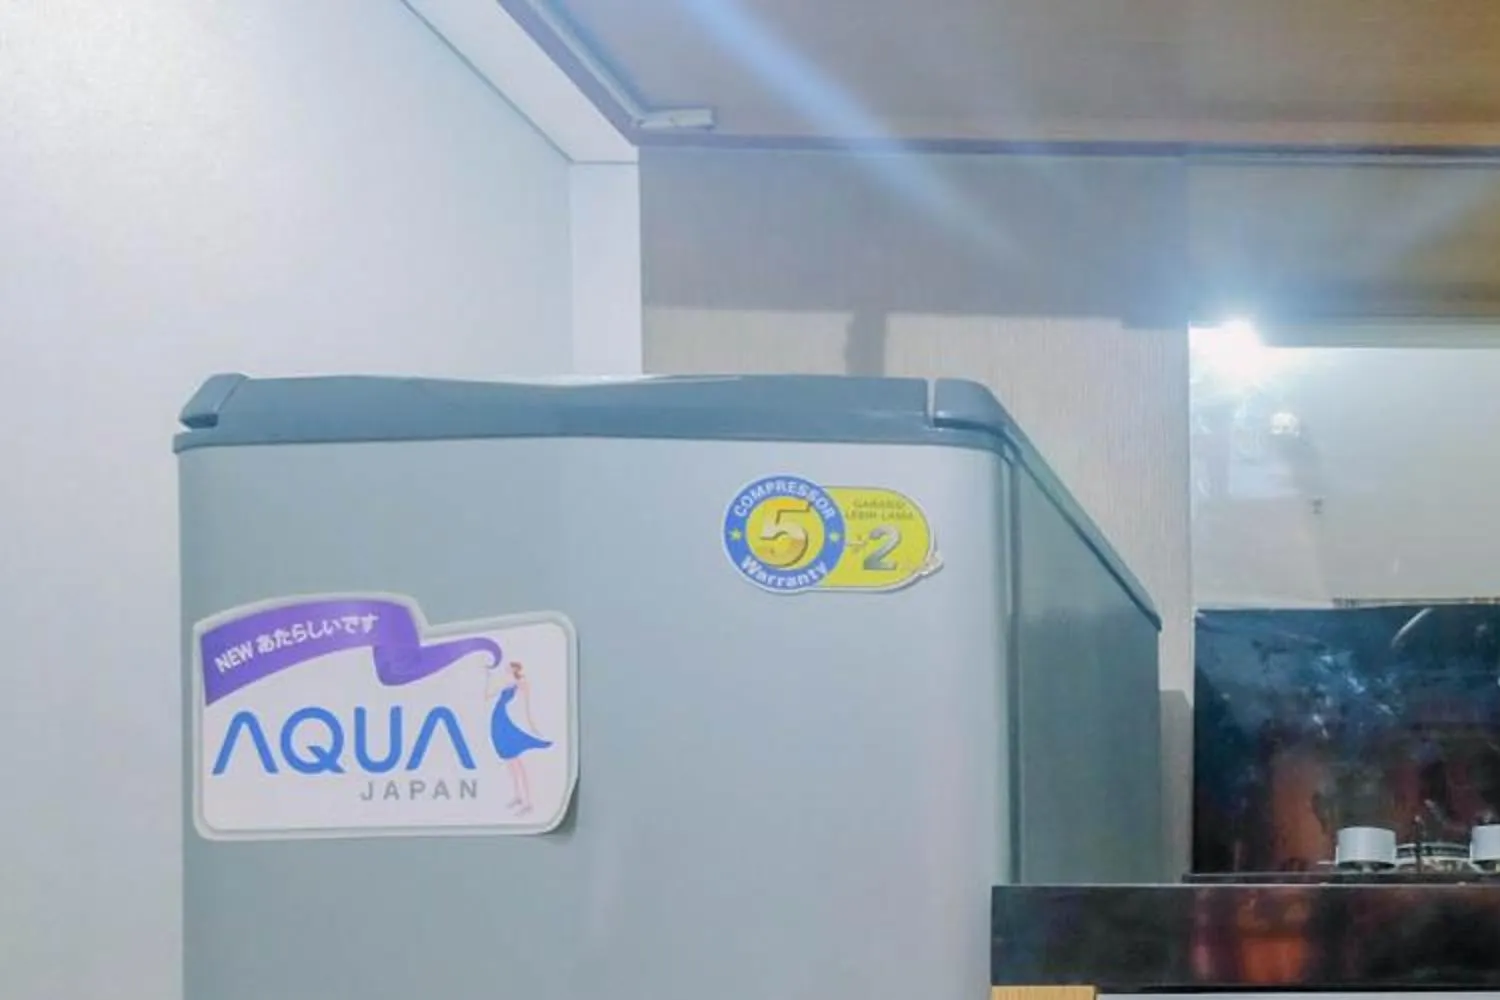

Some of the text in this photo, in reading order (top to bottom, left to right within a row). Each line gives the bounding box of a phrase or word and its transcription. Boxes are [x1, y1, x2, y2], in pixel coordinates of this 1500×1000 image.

[735, 479, 836, 518] COMPRESSOR
[759, 499, 810, 568] 5
[740, 555, 828, 587] Warranty
[214, 613, 379, 673] NEW あたらしいです
[212, 706, 477, 775] AQUA
[361, 779, 477, 800] JAPAN
